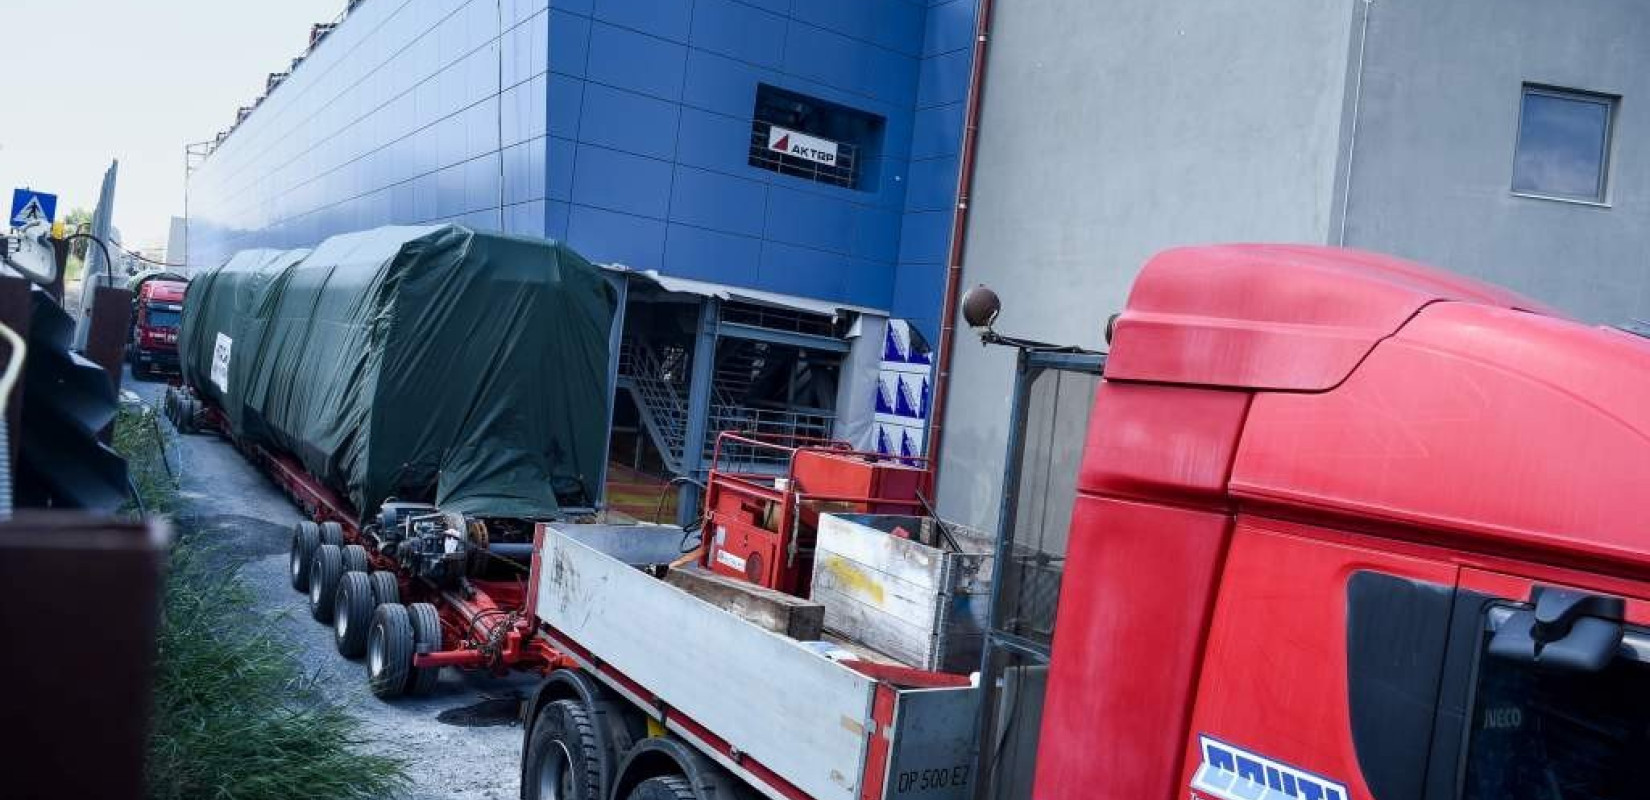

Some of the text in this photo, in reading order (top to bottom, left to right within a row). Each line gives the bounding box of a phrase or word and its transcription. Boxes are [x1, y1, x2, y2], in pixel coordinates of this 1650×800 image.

[1484, 707, 1521, 730] IVECO
[898, 771, 918, 793] DP
[921, 768, 949, 790] 500
